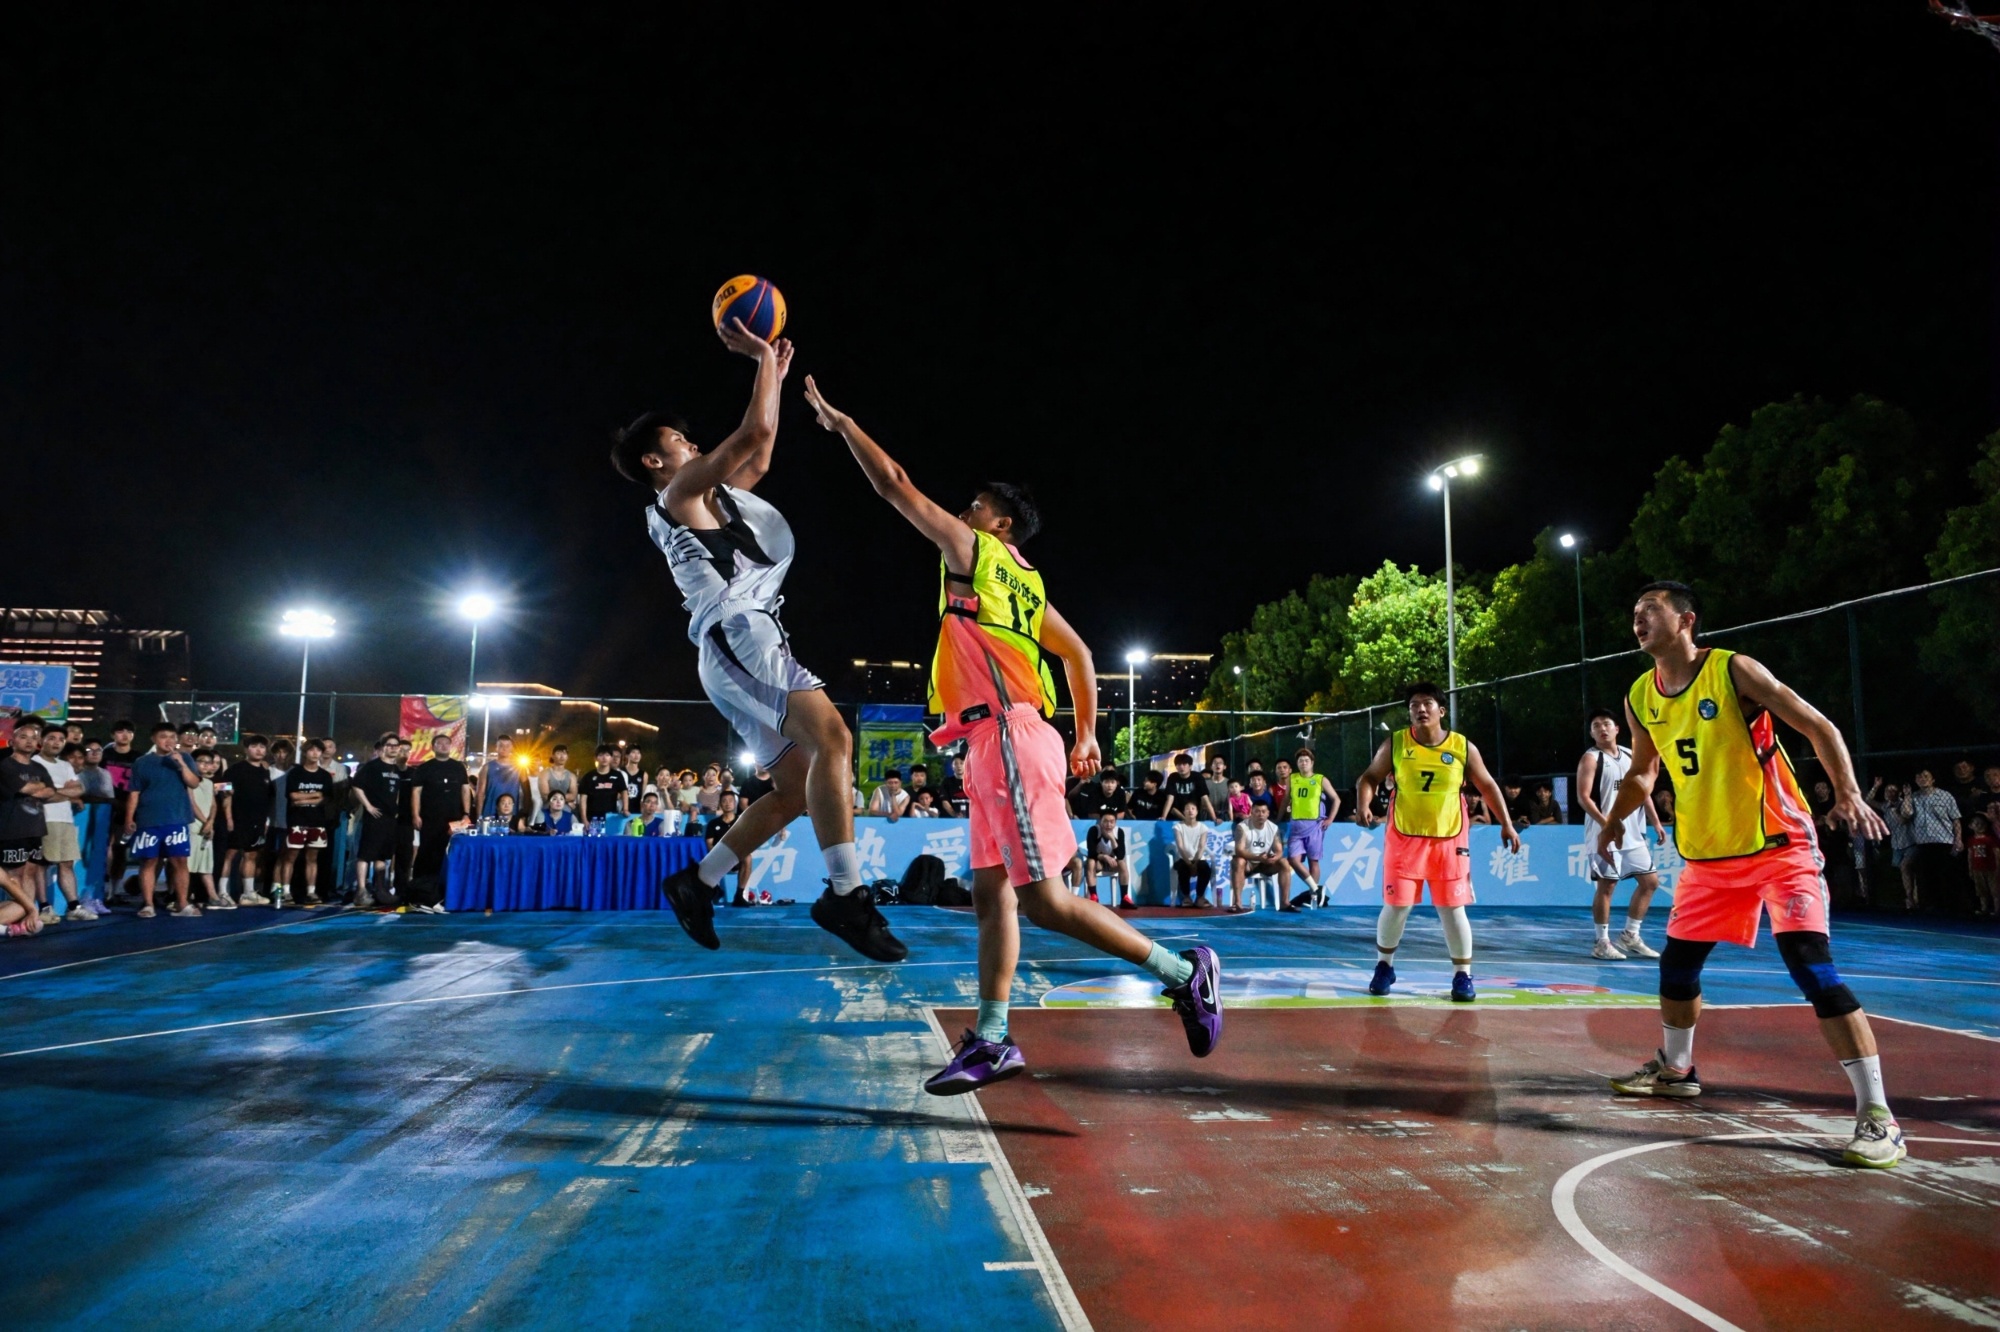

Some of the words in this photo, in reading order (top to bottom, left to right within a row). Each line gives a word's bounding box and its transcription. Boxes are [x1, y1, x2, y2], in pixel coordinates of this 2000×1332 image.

[995, 563, 1043, 610] 维动体育
[1675, 738, 1700, 777] 5
[1297, 787, 1308, 798] 10
[1421, 771, 1434, 792] 7
